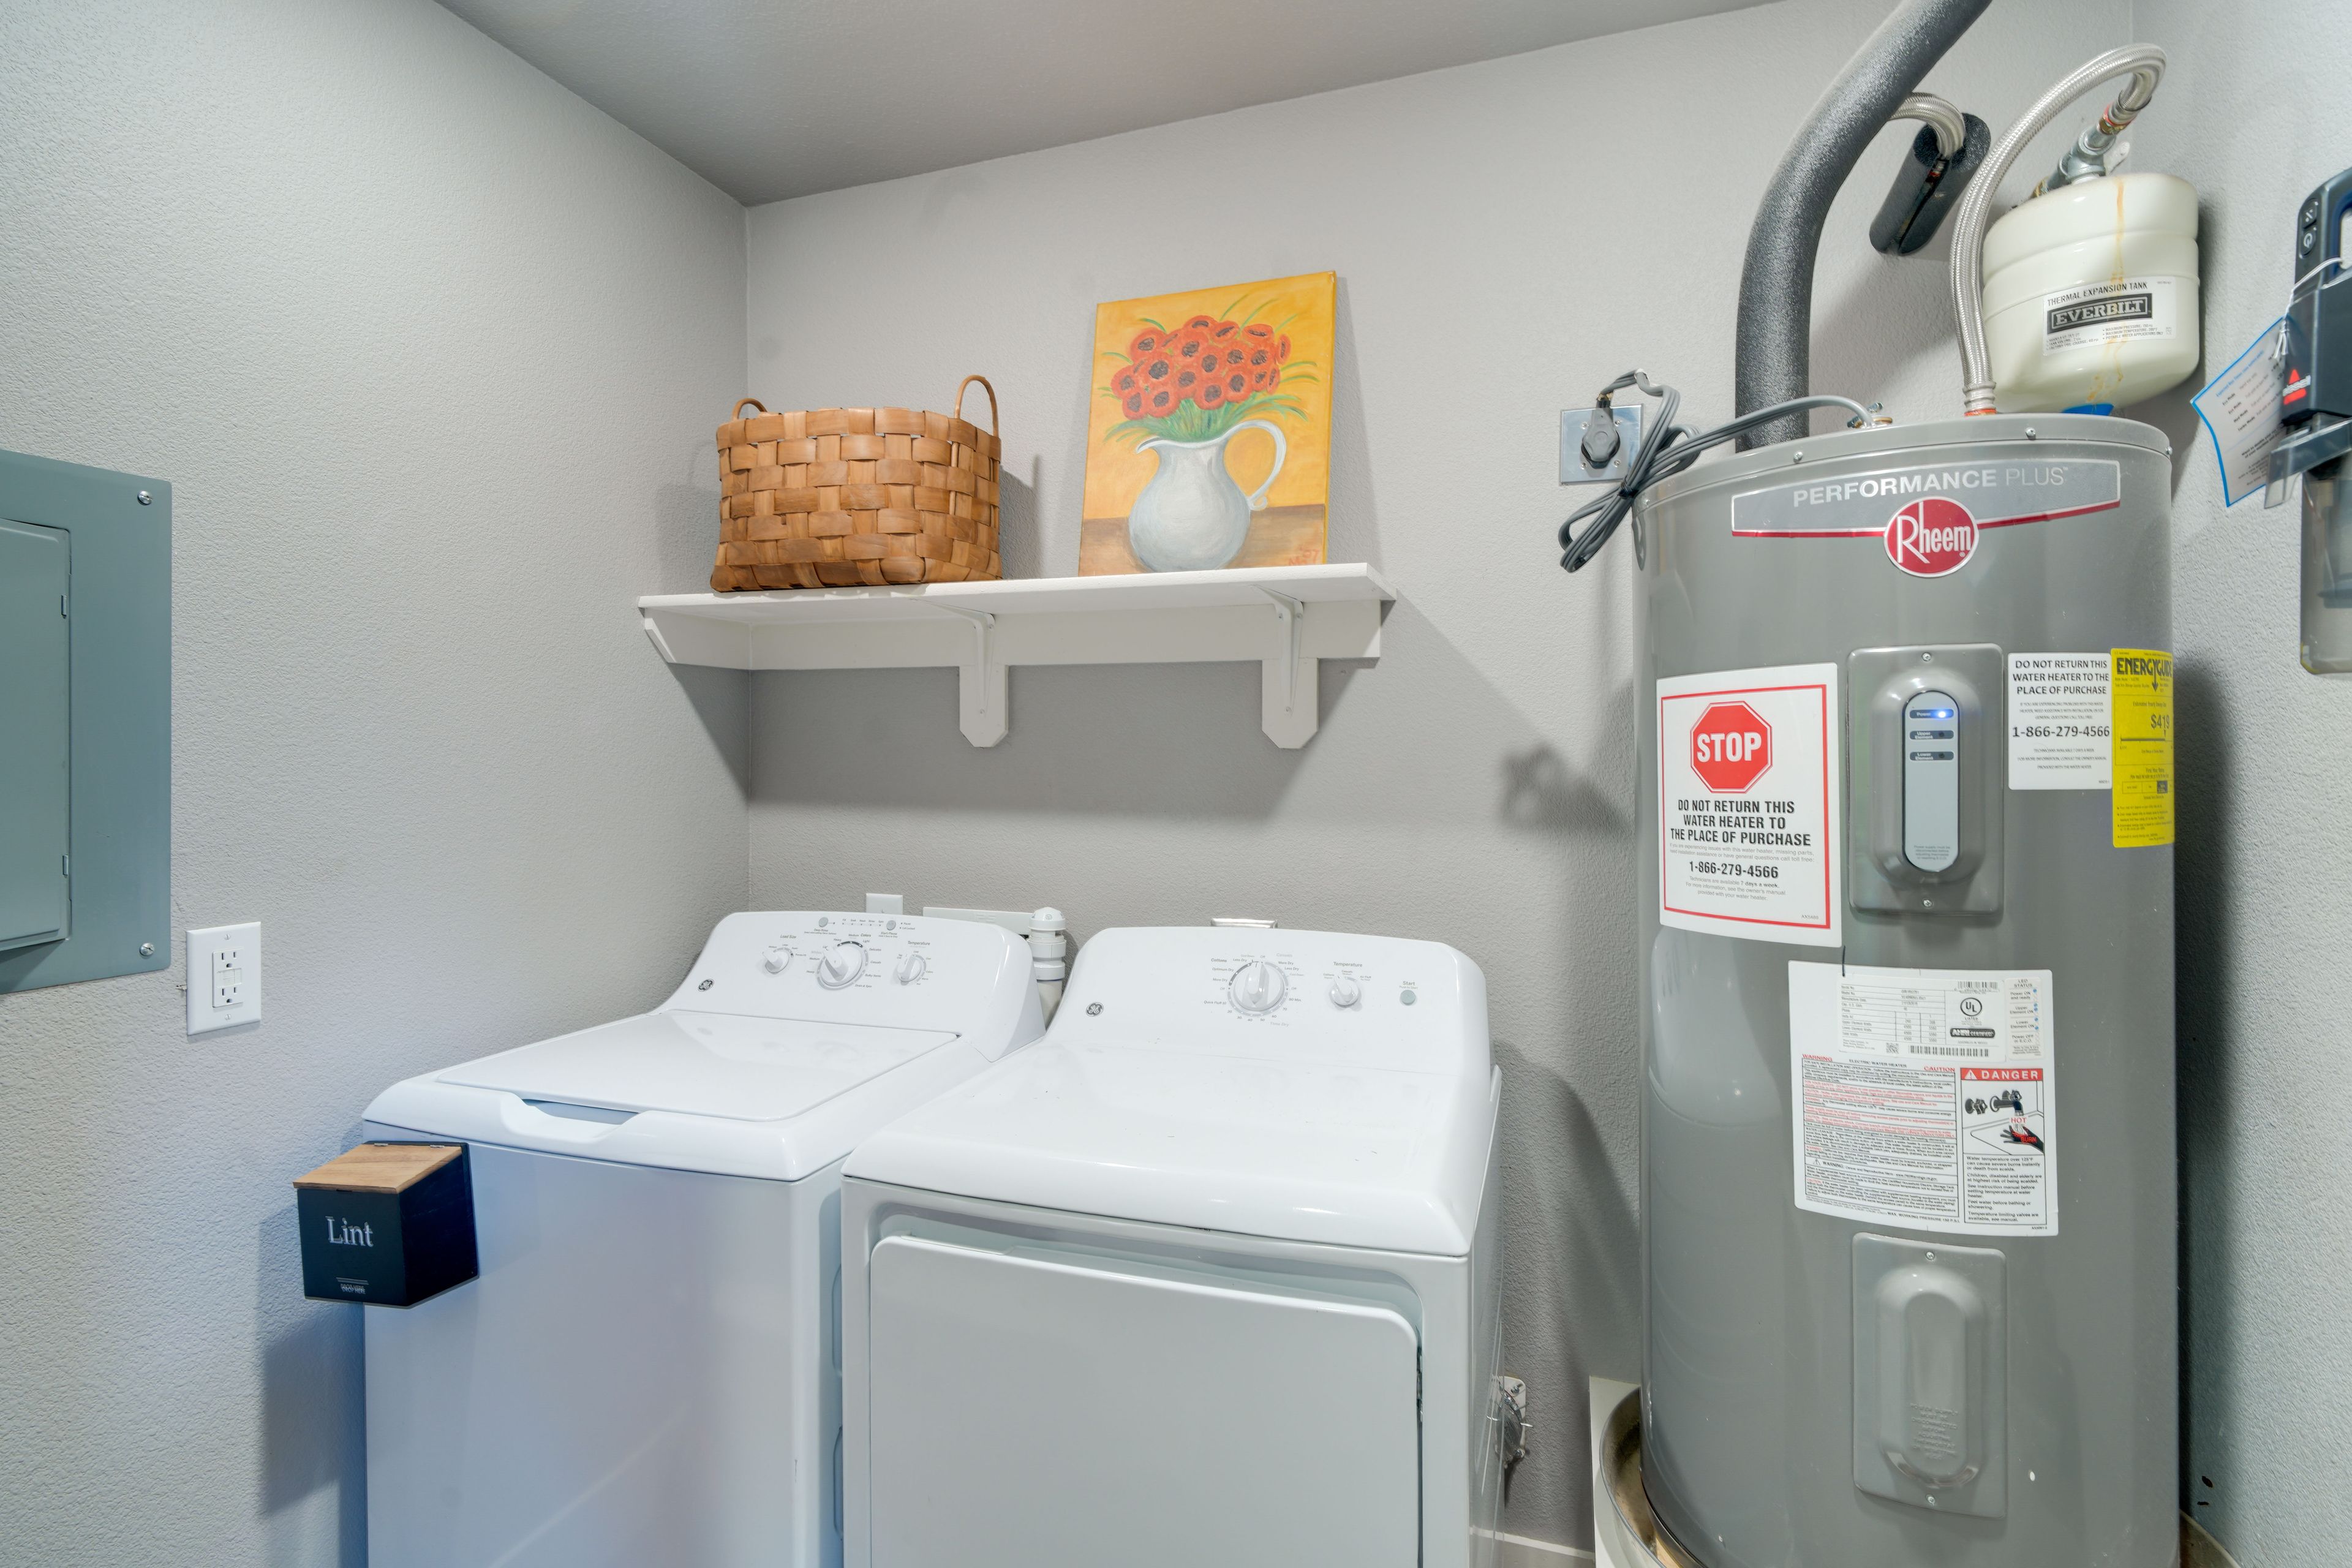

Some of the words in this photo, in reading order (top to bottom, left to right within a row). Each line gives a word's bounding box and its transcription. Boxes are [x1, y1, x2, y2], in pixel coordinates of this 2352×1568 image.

[2048, 292, 2081, 306] THERMAL
[2084, 284, 2127, 298] EXPANSION
[2130, 281, 2148, 290] TANK
[2056, 300, 2143, 325] EVERBILT
[1793, 469, 1997, 507] PERFORMANCE
[1896, 500, 1972, 564] Rheem
[2151, 714, 2169, 729] $419
[2013, 726, 2109, 737] 1-866-279-4566
[1697, 731, 1762, 762] STOP
[1678, 799, 1689, 811] DO
[1692, 800, 1710, 812] NOT
[1714, 801, 1760, 813] RETURN
[1765, 801, 1795, 813] THIS
[1684, 814, 1715, 827] WATER
[1719, 816, 1764, 829] HEATER
[1769, 817, 1785, 829] TO
[1671, 828, 1685, 840] THE
[1688, 829, 1718, 842] PLACE
[1722, 831, 1736, 843] OF
[1741, 832, 1811, 846] PURCHASE
[1689, 861, 1779, 879] 1-866-279-4566
[1966, 1001, 1977, 1012] UL
[1981, 1071, 2038, 1079] DANGER
[325, 1216, 374, 1247] Lint
